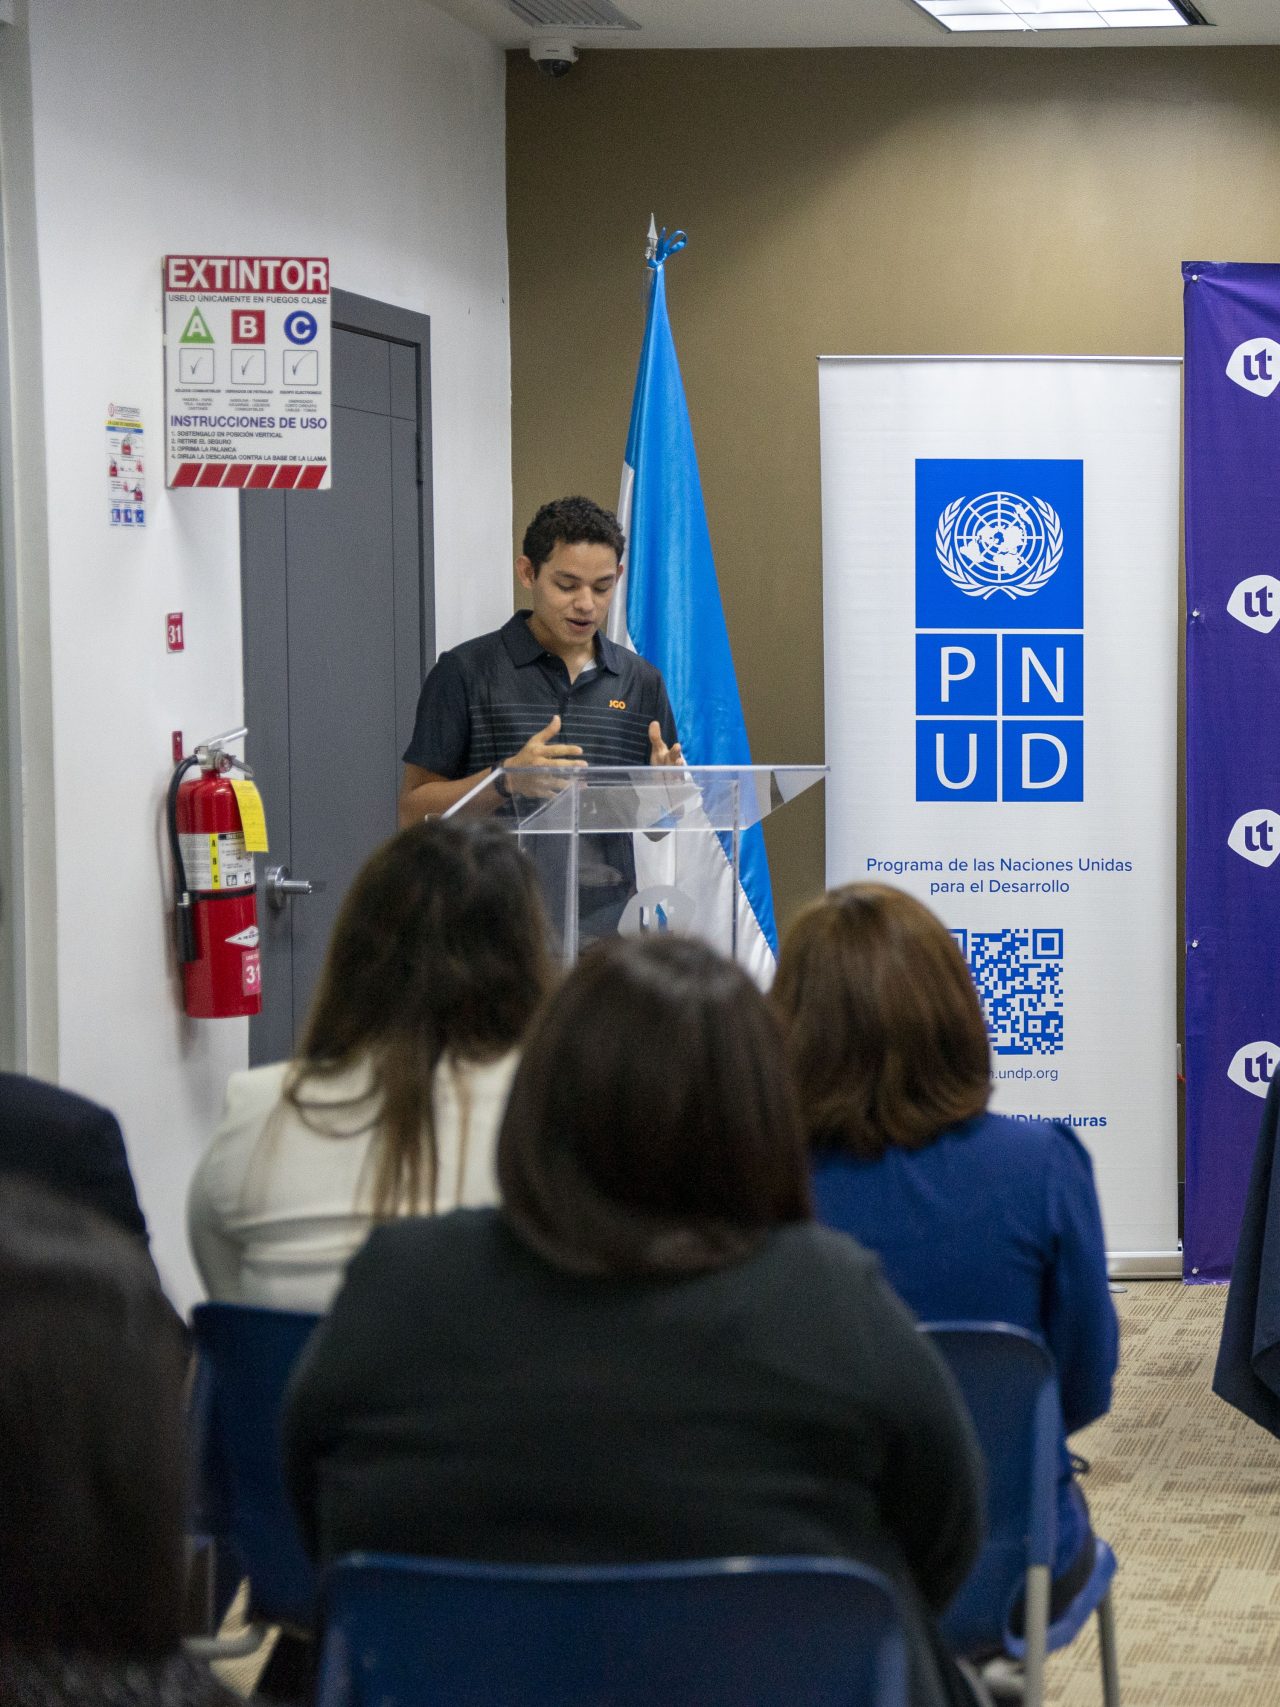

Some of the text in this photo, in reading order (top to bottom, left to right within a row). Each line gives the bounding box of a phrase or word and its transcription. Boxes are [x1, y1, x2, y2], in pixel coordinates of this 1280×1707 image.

[168, 258, 327, 291] EXTINTOR
[266, 296, 298, 304] FUEGOS
[300, 296, 327, 304] CLASE
[187, 315, 207, 337] A
[239, 316, 257, 338] B
[290, 316, 311, 339] C
[171, 415, 327, 429] INSTRUCCIONES DE USO
[168, 625, 182, 643] 31
[941, 647, 1064, 703] P N
[936, 733, 1067, 789] U D
[867, 858, 1132, 874] Programa de las Naciones Unidas
[931, 880, 1069, 895] para el Desarrollo
